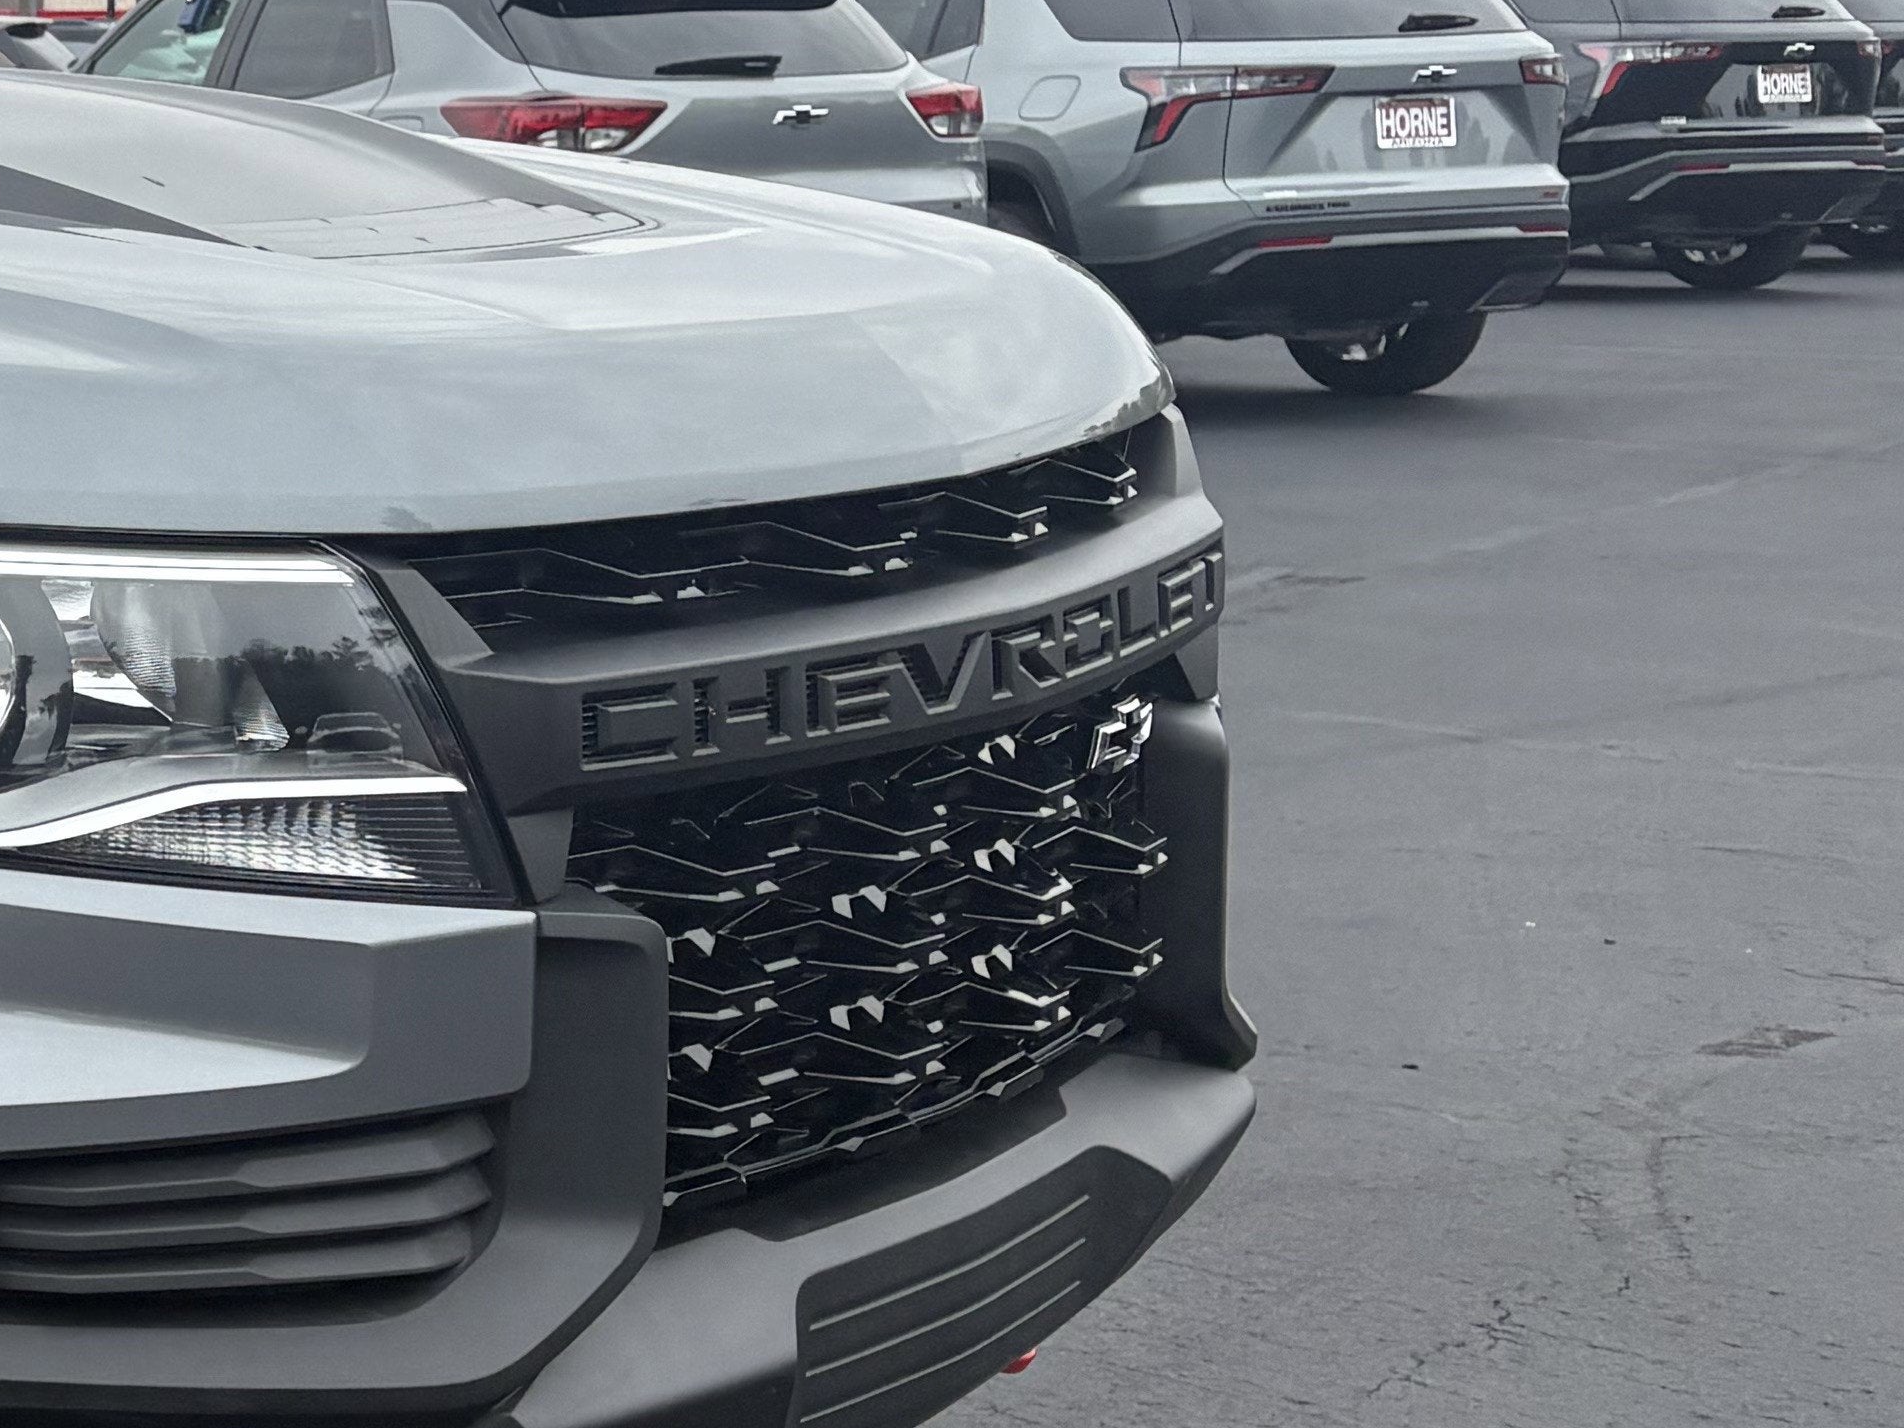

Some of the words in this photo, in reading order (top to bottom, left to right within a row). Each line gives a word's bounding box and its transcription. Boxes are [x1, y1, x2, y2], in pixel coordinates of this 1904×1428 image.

[1762, 72, 1809, 95] HORNE
[1381, 105, 1449, 138] HORNE
[581, 550, 1224, 772] CHEVROLET
